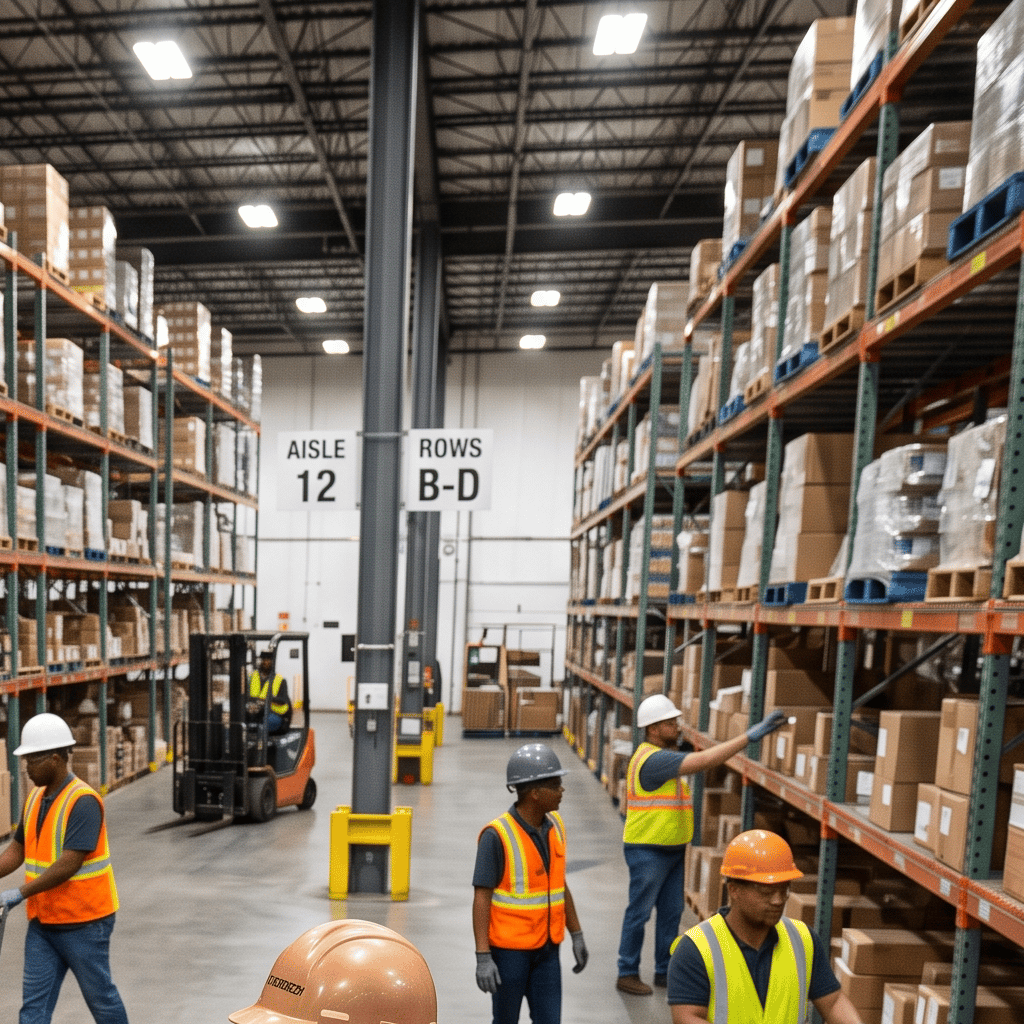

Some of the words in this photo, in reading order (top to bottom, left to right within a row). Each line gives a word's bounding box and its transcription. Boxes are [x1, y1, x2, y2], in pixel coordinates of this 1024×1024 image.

[287, 439, 346, 460] AISLE
[419, 438, 482, 459] ROWS
[297, 469, 336, 503] 12
[419, 468, 480, 502] B-D
